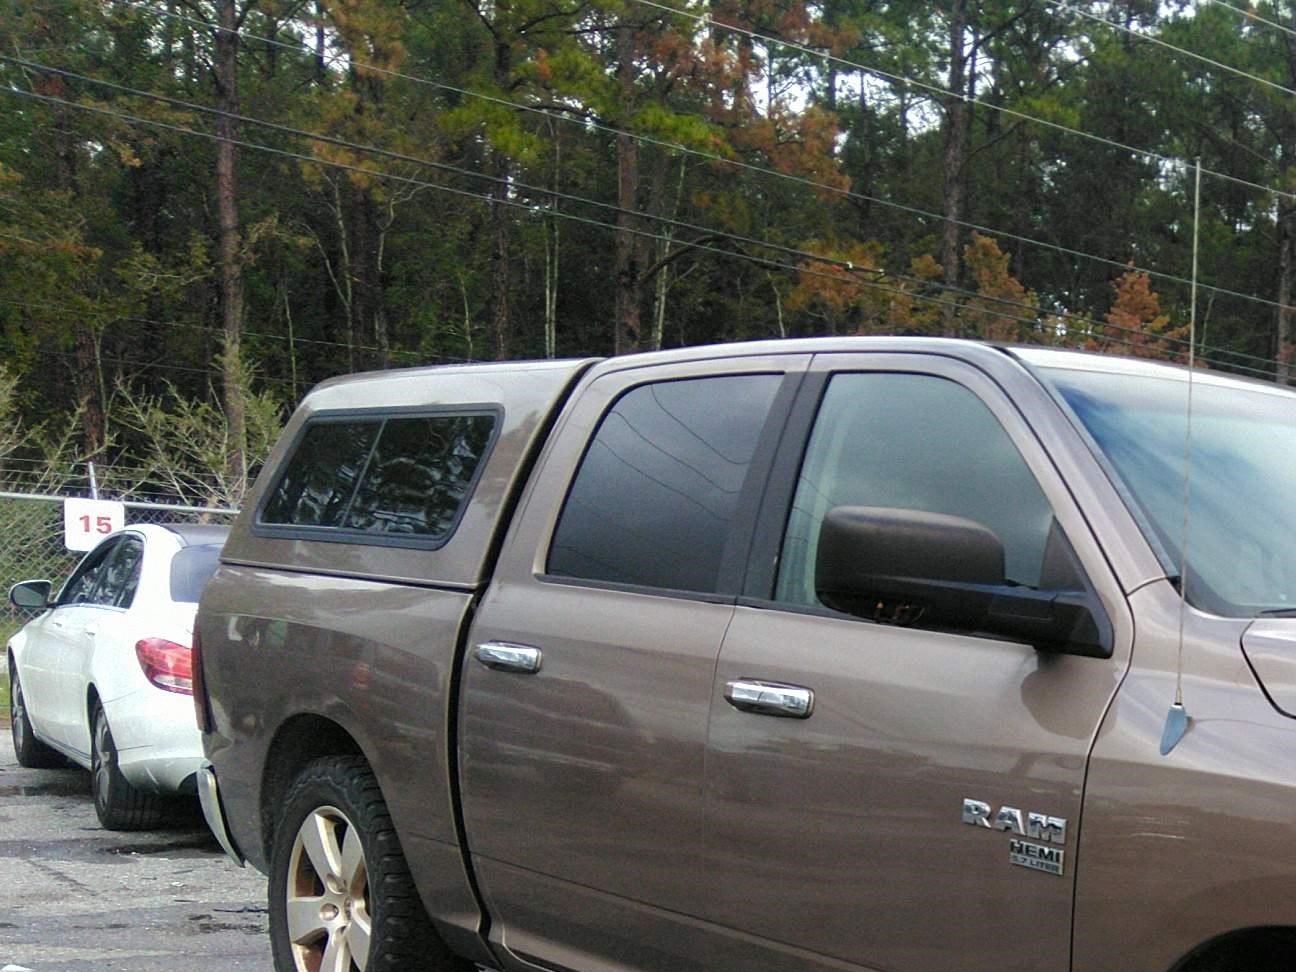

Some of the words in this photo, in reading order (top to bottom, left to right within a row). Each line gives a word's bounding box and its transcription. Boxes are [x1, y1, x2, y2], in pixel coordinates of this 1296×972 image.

[79, 515, 113, 534] 15
[963, 798, 1066, 844] RAM
[1010, 840, 1061, 864] HEMI
